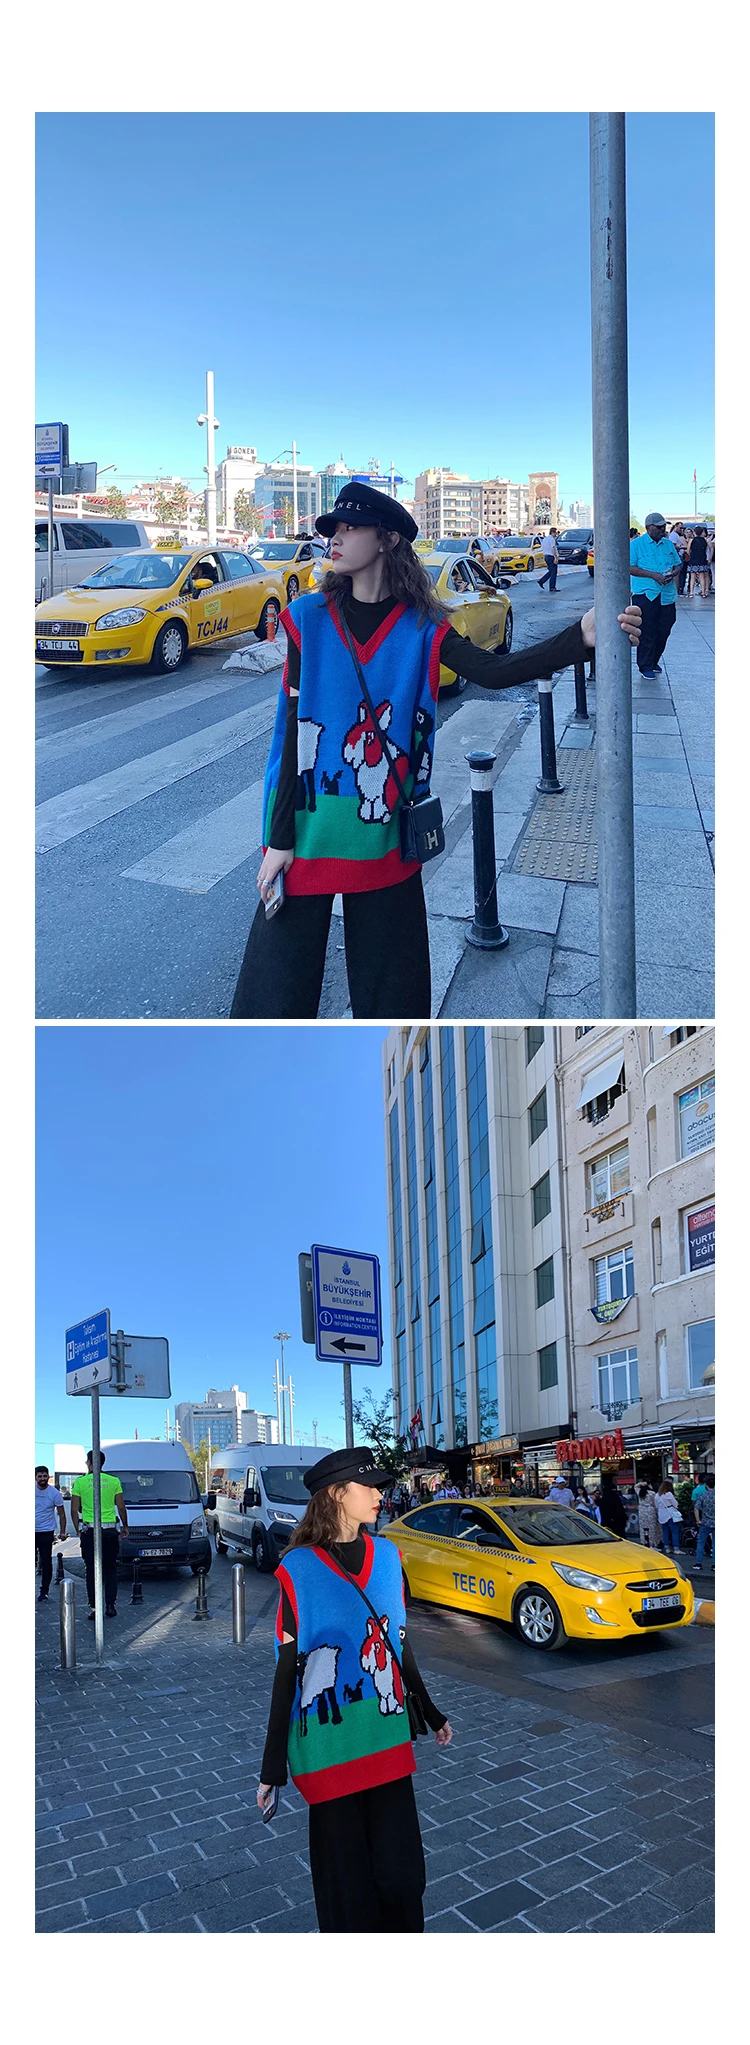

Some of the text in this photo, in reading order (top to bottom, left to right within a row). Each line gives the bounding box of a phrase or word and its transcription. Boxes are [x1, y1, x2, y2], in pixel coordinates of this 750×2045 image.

[197, 616, 229, 639] TCJ44
[40, 640, 77, 650] 34 TCJ 44
[322, 1283, 372, 1299] BÜYÜKŞEHİR
[556, 1427, 624, 1463] BAMBİ
[452, 1571, 496, 1599] TEE 06
[647, 1599, 655, 1609] 34
[660, 1597, 670, 1607] TEE
